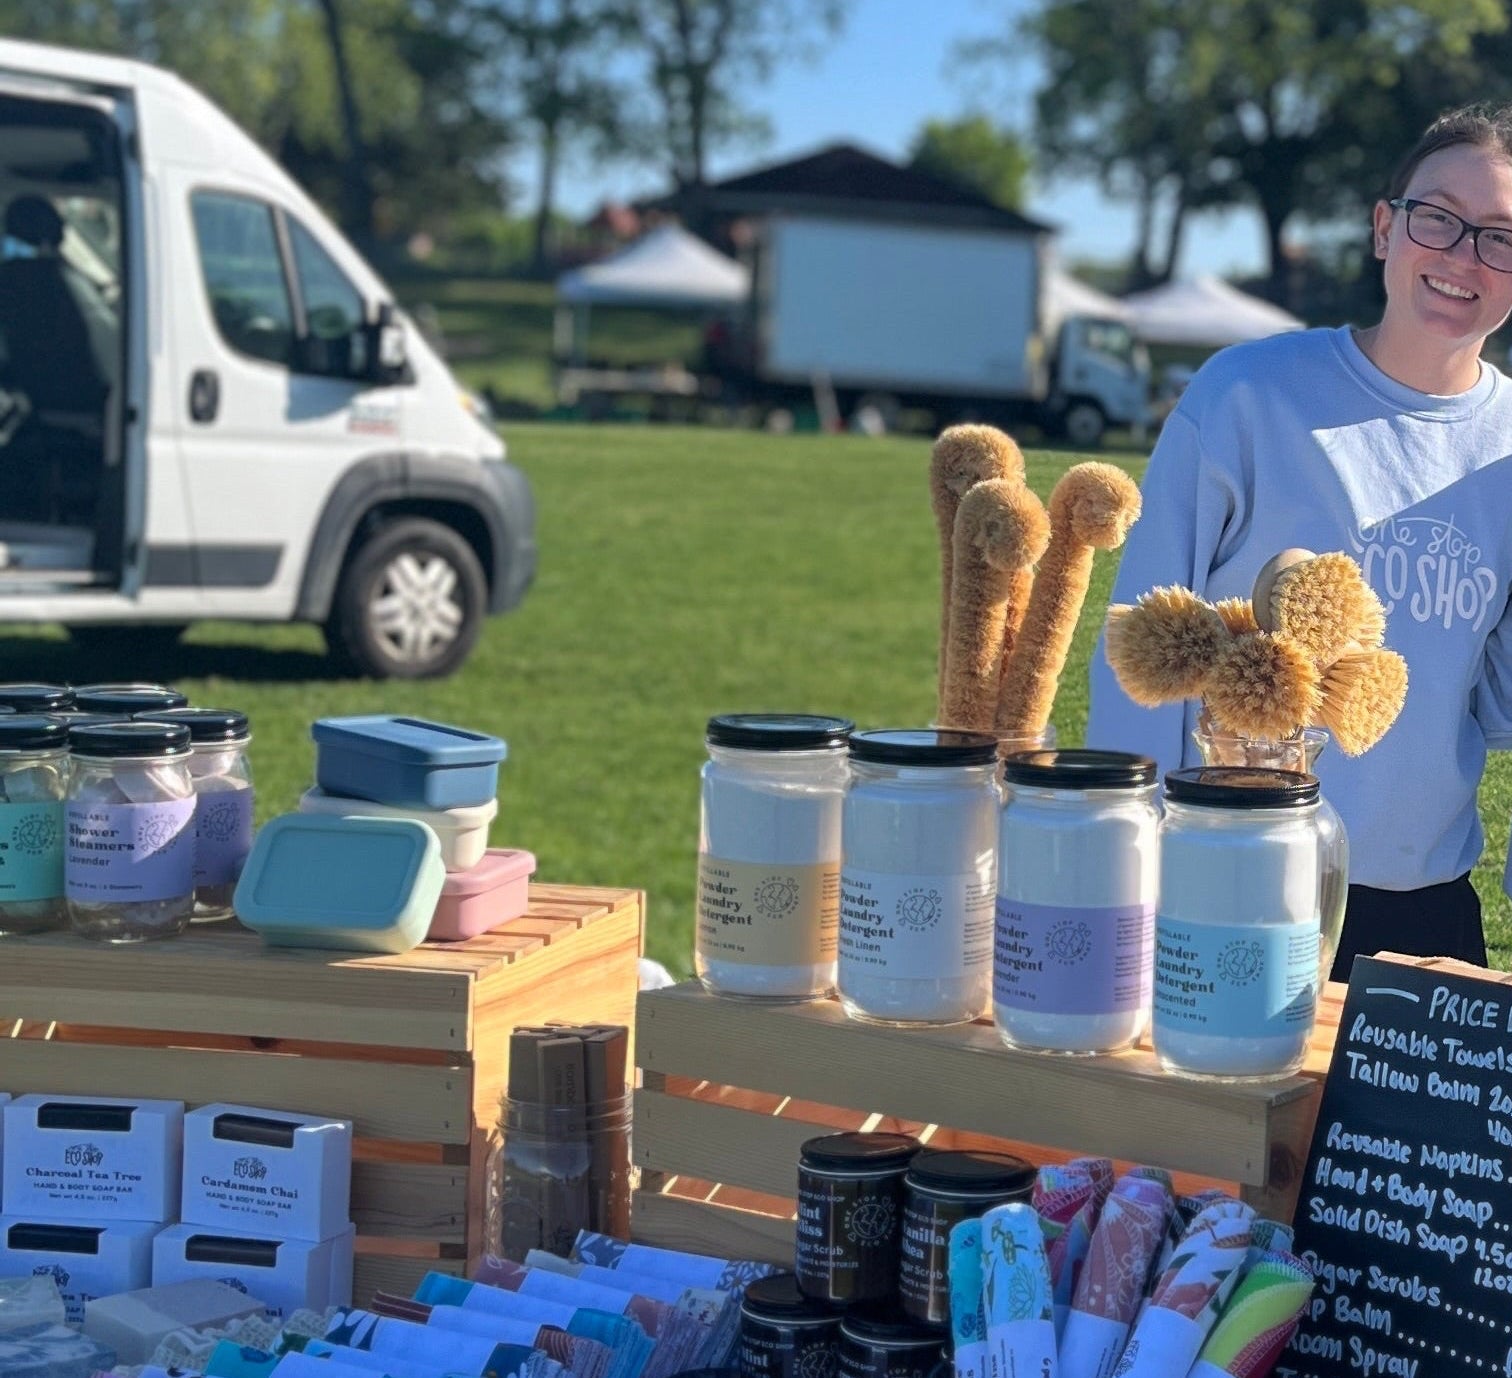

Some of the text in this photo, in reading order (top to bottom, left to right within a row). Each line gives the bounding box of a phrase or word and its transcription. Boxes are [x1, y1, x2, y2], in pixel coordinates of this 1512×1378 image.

[1405, 513, 1482, 574] stop
[1409, 554, 1498, 633] SHOP
[69, 823, 120, 837] Shower
[69, 836, 135, 851] Steamers
[69, 856, 111, 867] Lavender
[856, 940, 881, 953] Linen
[1428, 985, 1500, 1029] PRICE
[1349, 1011, 1439, 1062] Reusable
[1346, 1050, 1420, 1094] Tallow
[1427, 1070, 1482, 1107] Balm
[1326, 1121, 1413, 1165] Reusable
[26, 1167, 142, 1182] Charcoal Tea Tree
[33, 1182, 58, 1190] HAND
[92, 1184, 114, 1192] SOAP
[201, 1175, 298, 1200] Cardamom Chai
[256, 1198, 276, 1208] SOAP
[277, 1202, 292, 1210] BAR
[1309, 1196, 1362, 1232] Solid
[1364, 1209, 1411, 1246] Dish
[1416, 1221, 1470, 1263] Soap
[813, 1243, 845, 1257] Scrub
[915, 1265, 944, 1281] Scrub
